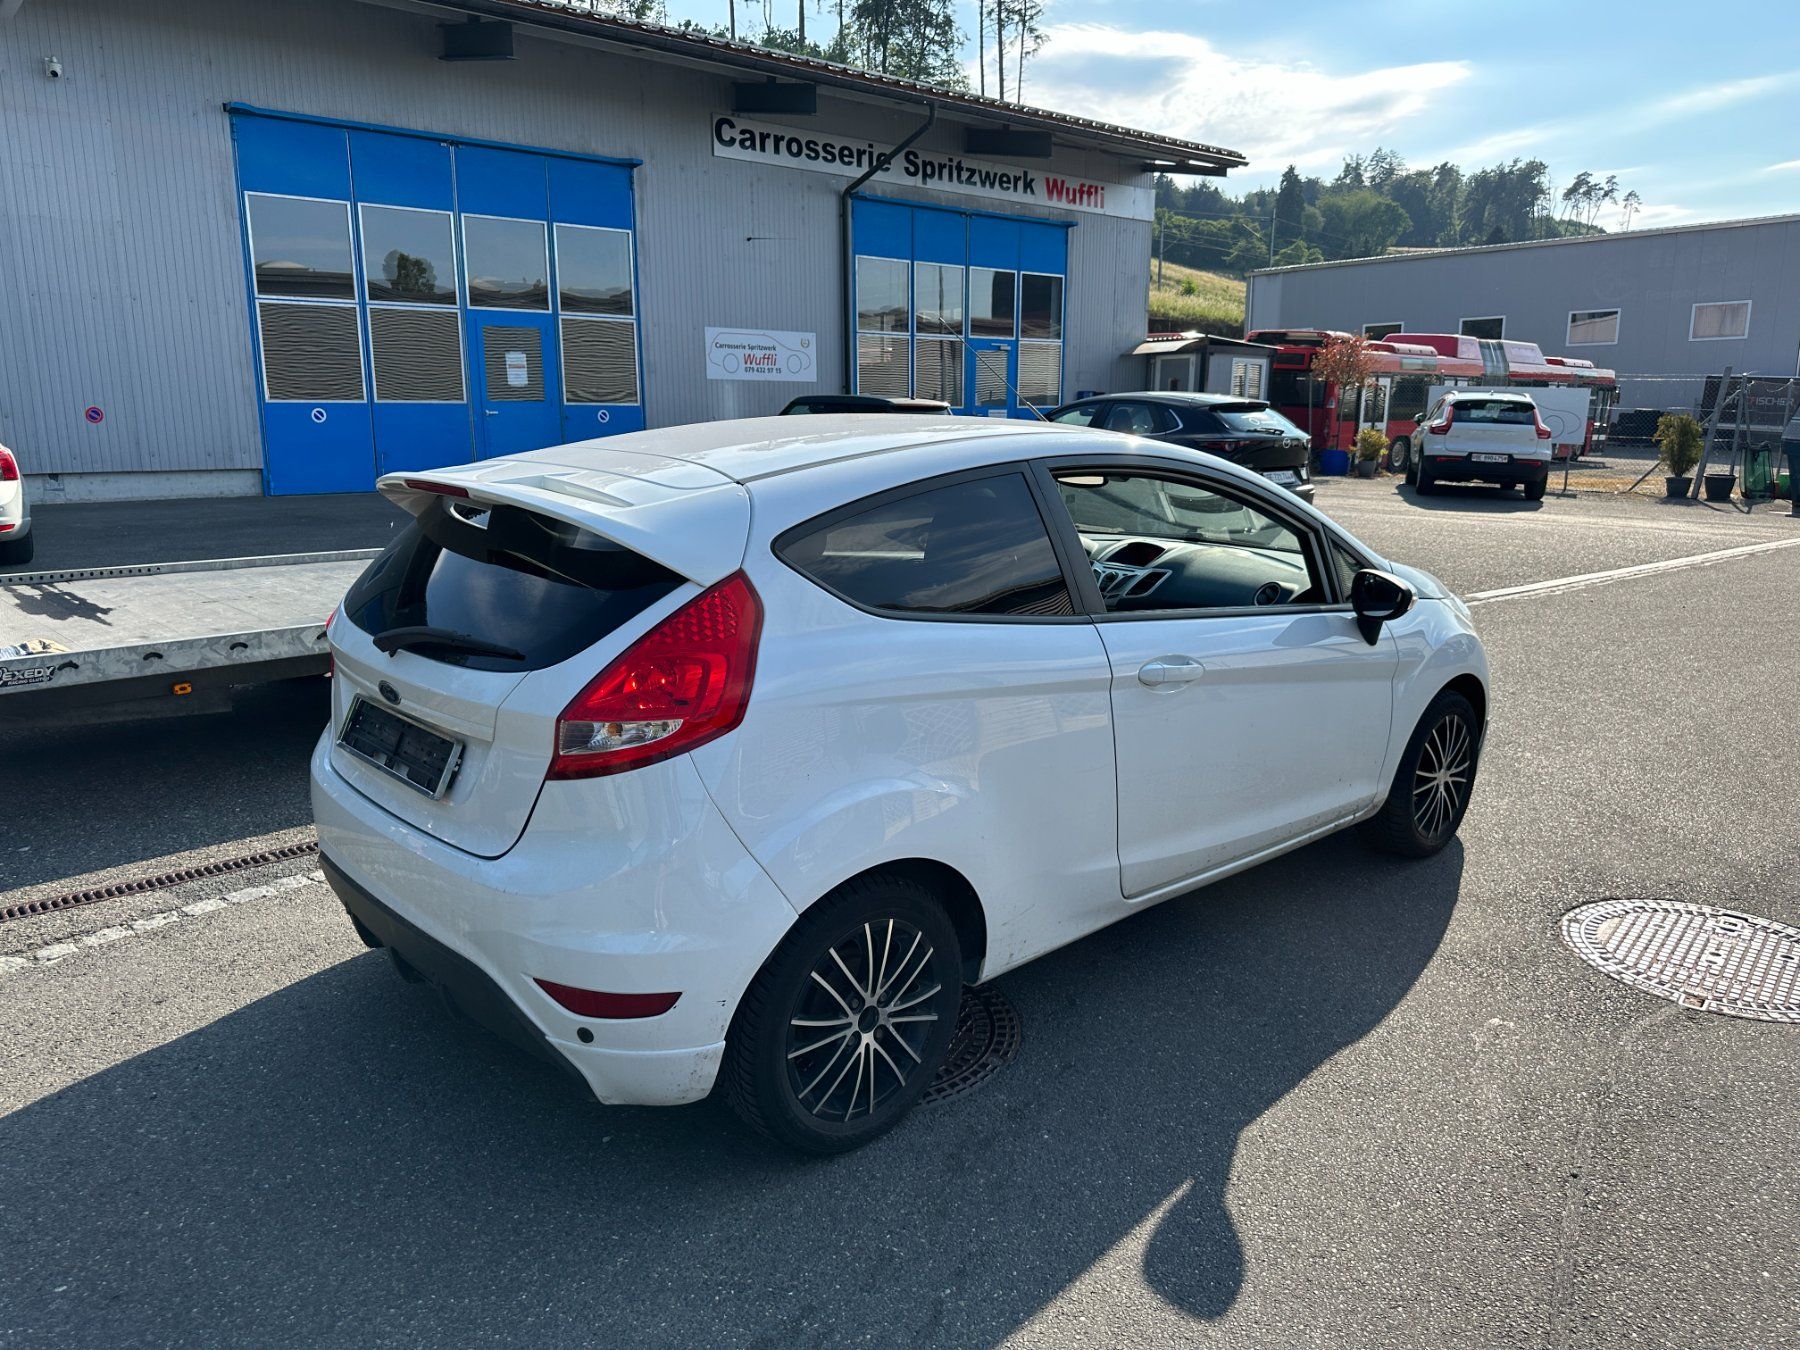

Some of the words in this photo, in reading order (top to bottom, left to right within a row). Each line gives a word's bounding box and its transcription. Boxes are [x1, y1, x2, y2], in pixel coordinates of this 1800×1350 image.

[714, 117, 892, 172] Carrosserie
[904, 150, 1036, 196] Spritzwerk
[1045, 176, 1105, 209] Wuffli
[715, 342, 746, 350] Carrosserie
[747, 343, 776, 352] Spritzwerk
[743, 353, 777, 366] Wuffli
[3, 666, 54, 681] EXEDY
